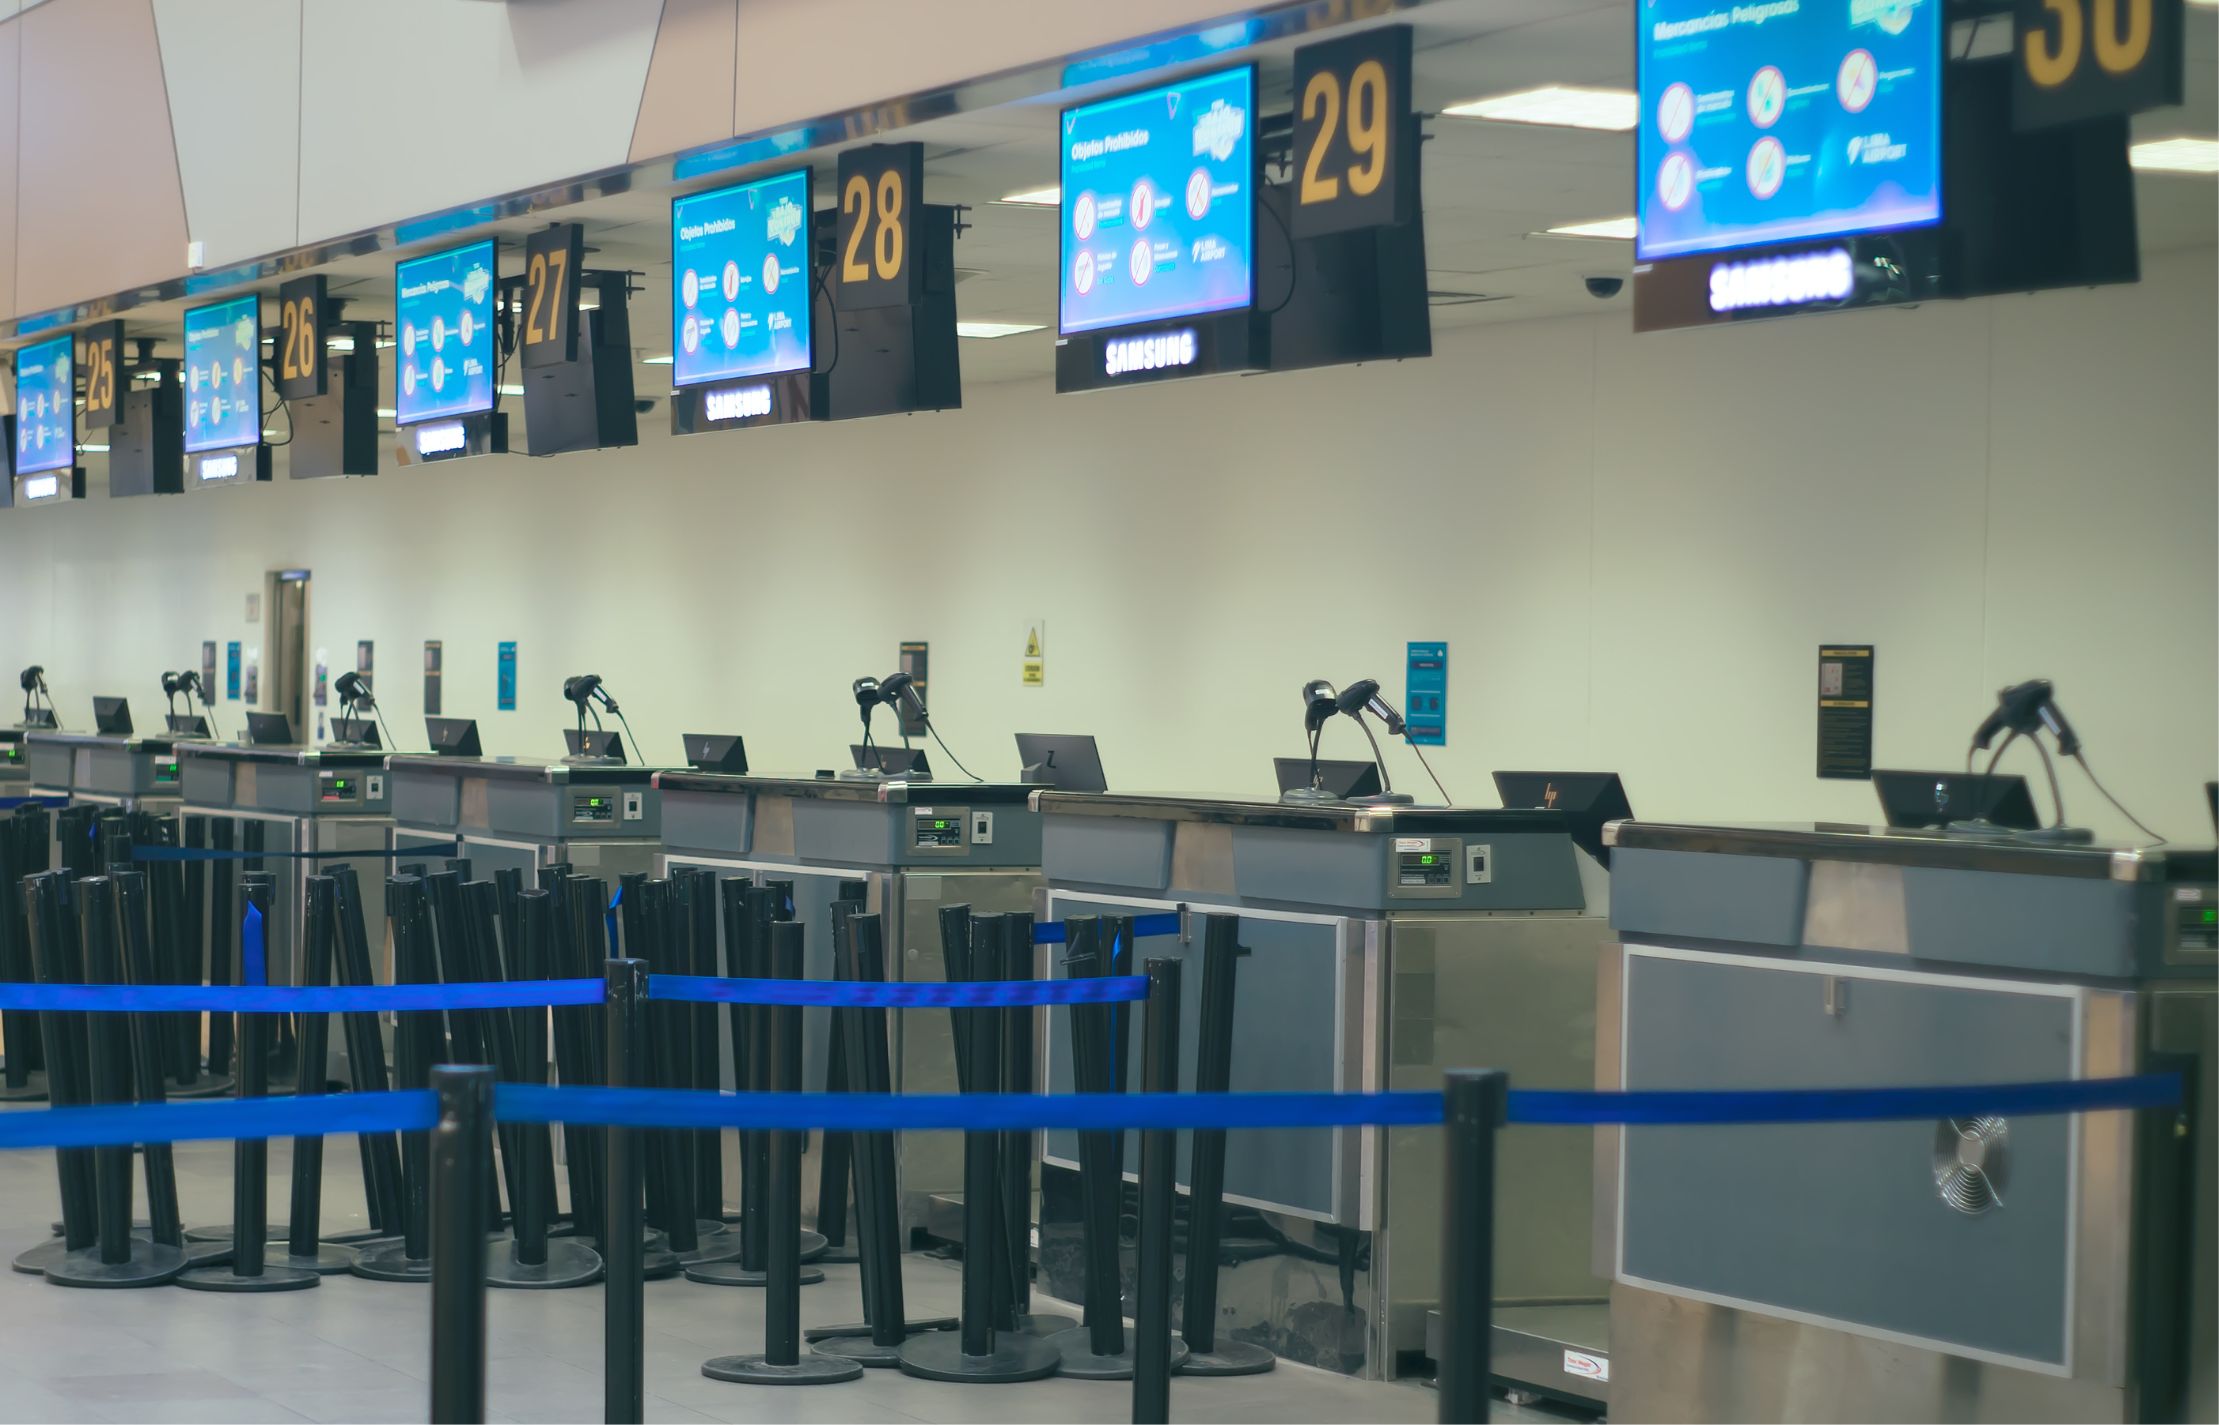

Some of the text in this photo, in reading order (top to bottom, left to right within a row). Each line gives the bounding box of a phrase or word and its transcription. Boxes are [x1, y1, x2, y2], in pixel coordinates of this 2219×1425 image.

[1299, 60, 1388, 206] 29
[842, 169, 904, 284] 28
[282, 296, 316, 381] 26
[525, 249, 567, 345] 27
[87, 338, 114, 412] 25
[1105, 332, 1194, 376] SAMSUNG
[706, 386, 773, 422] SAMSUNG
